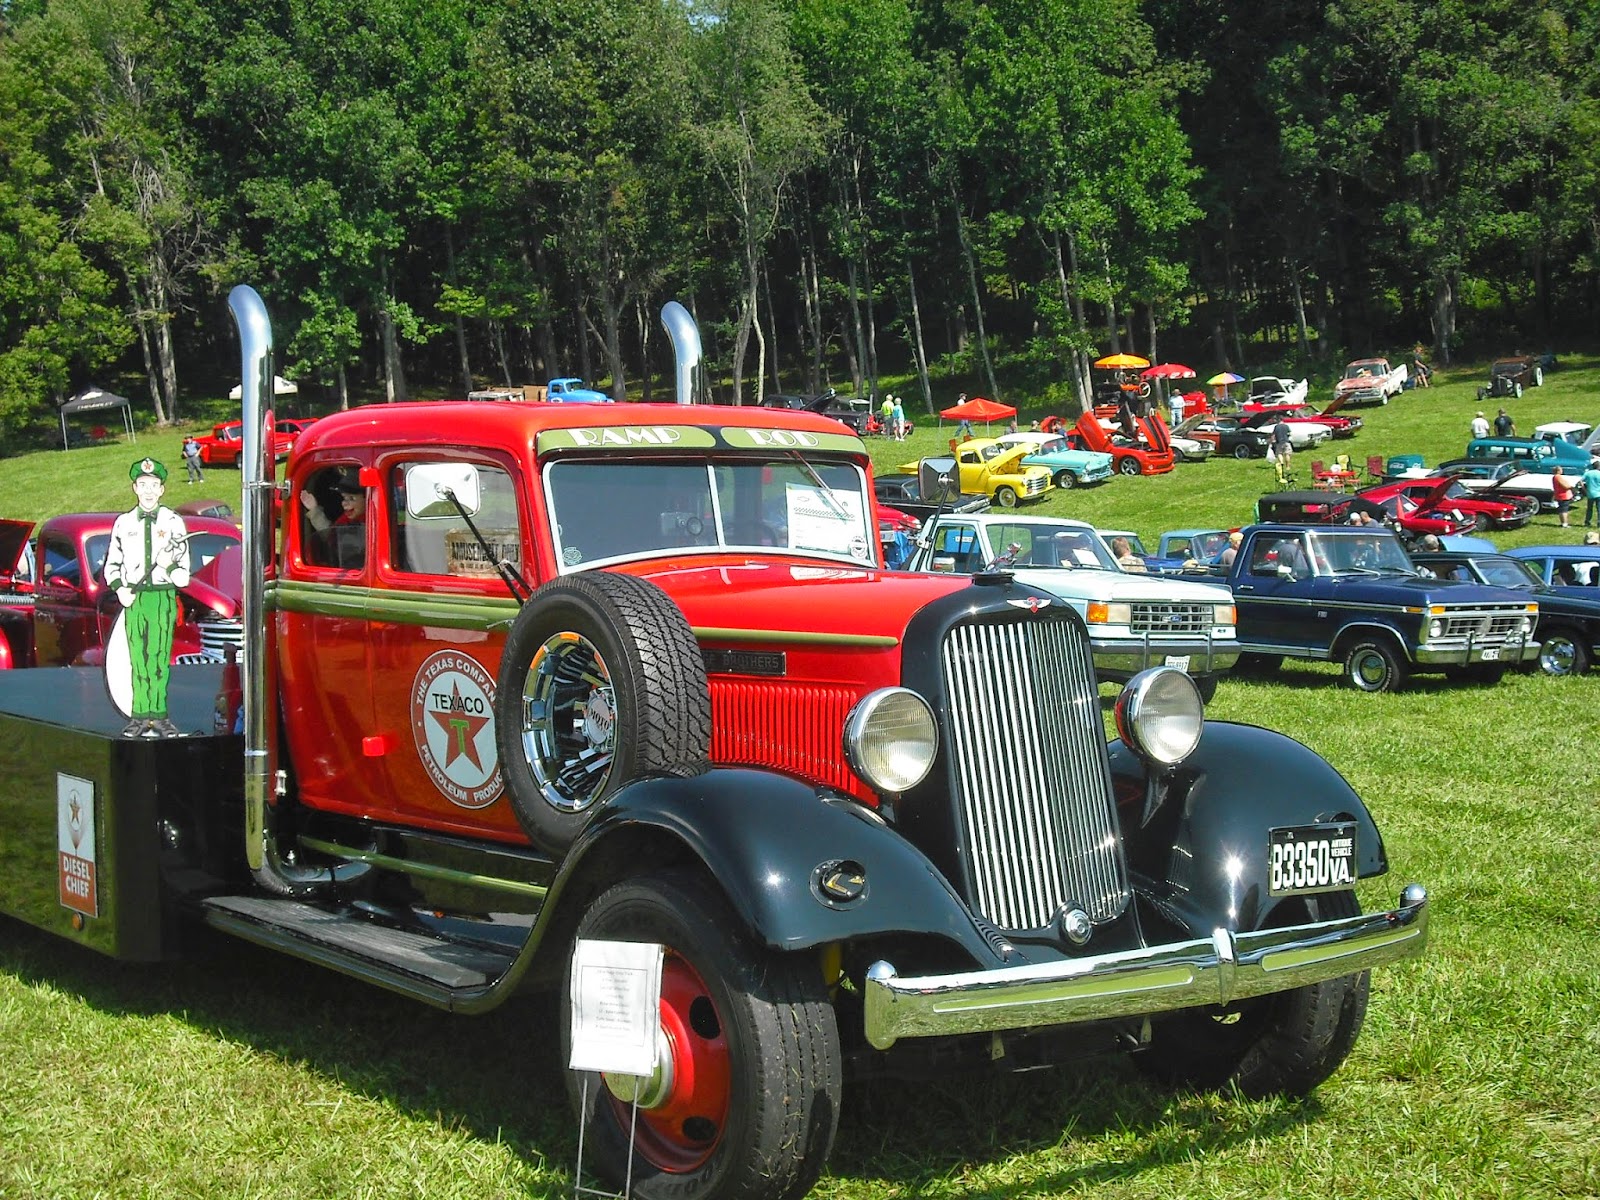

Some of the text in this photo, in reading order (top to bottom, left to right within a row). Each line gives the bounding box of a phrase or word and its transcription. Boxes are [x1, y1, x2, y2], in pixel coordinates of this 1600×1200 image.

[567, 427, 819, 447] RAMP ROD
[722, 653, 779, 669] BROTHERS
[416, 657, 497, 705] THE TEXAS COMPAN
[431, 692, 485, 715] TEXACO
[450, 718, 470, 753] T
[420, 744, 503, 802] PETROLEUM PRODUC
[1331, 847, 1353, 857] VEHICLE
[63, 855, 91, 880] DIESEL
[1273, 840, 1330, 890] B3350
[66, 874, 90, 898] CHIEF
